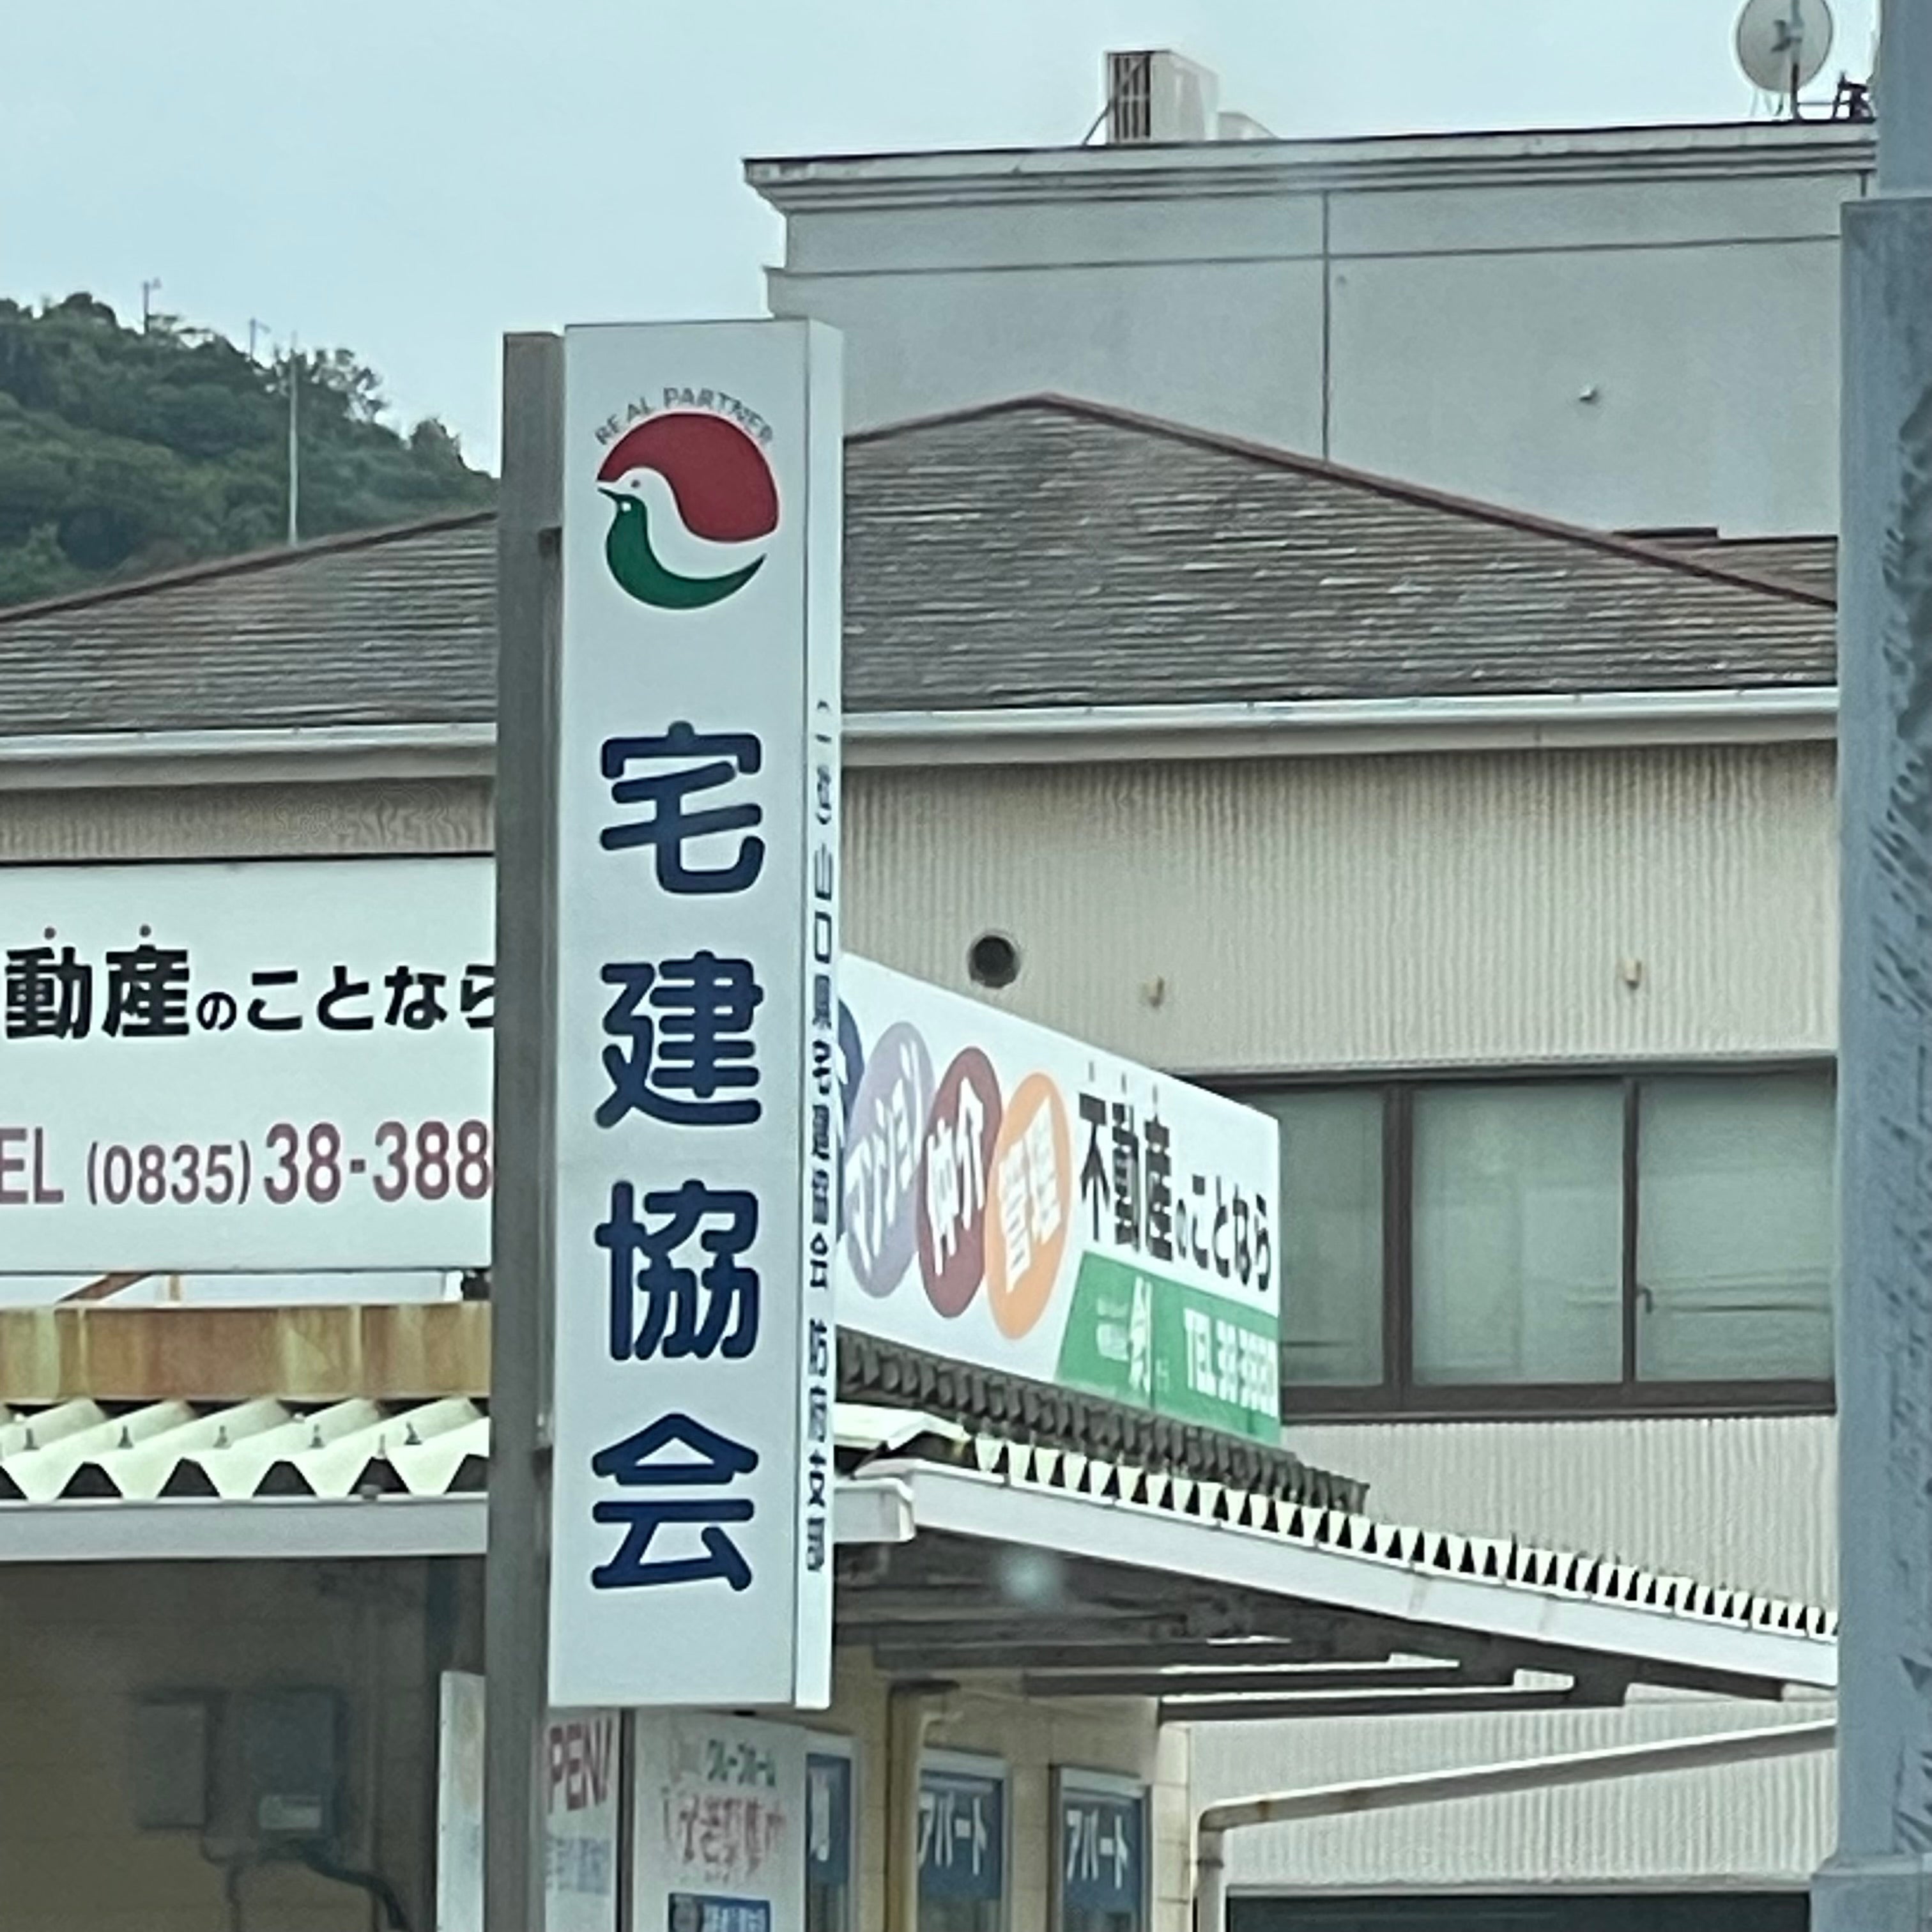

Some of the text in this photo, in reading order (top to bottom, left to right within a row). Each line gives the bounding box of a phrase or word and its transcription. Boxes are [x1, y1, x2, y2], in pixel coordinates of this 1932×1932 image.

[594, 387, 774, 445] REAL PARTNER
[592, 721, 765, 1592] 宅建協会
[927, 1077, 986, 1276] 仲介
[999, 1095, 1061, 1294] 管理
[1079, 1092, 1271, 1292] 不動産のことなら
